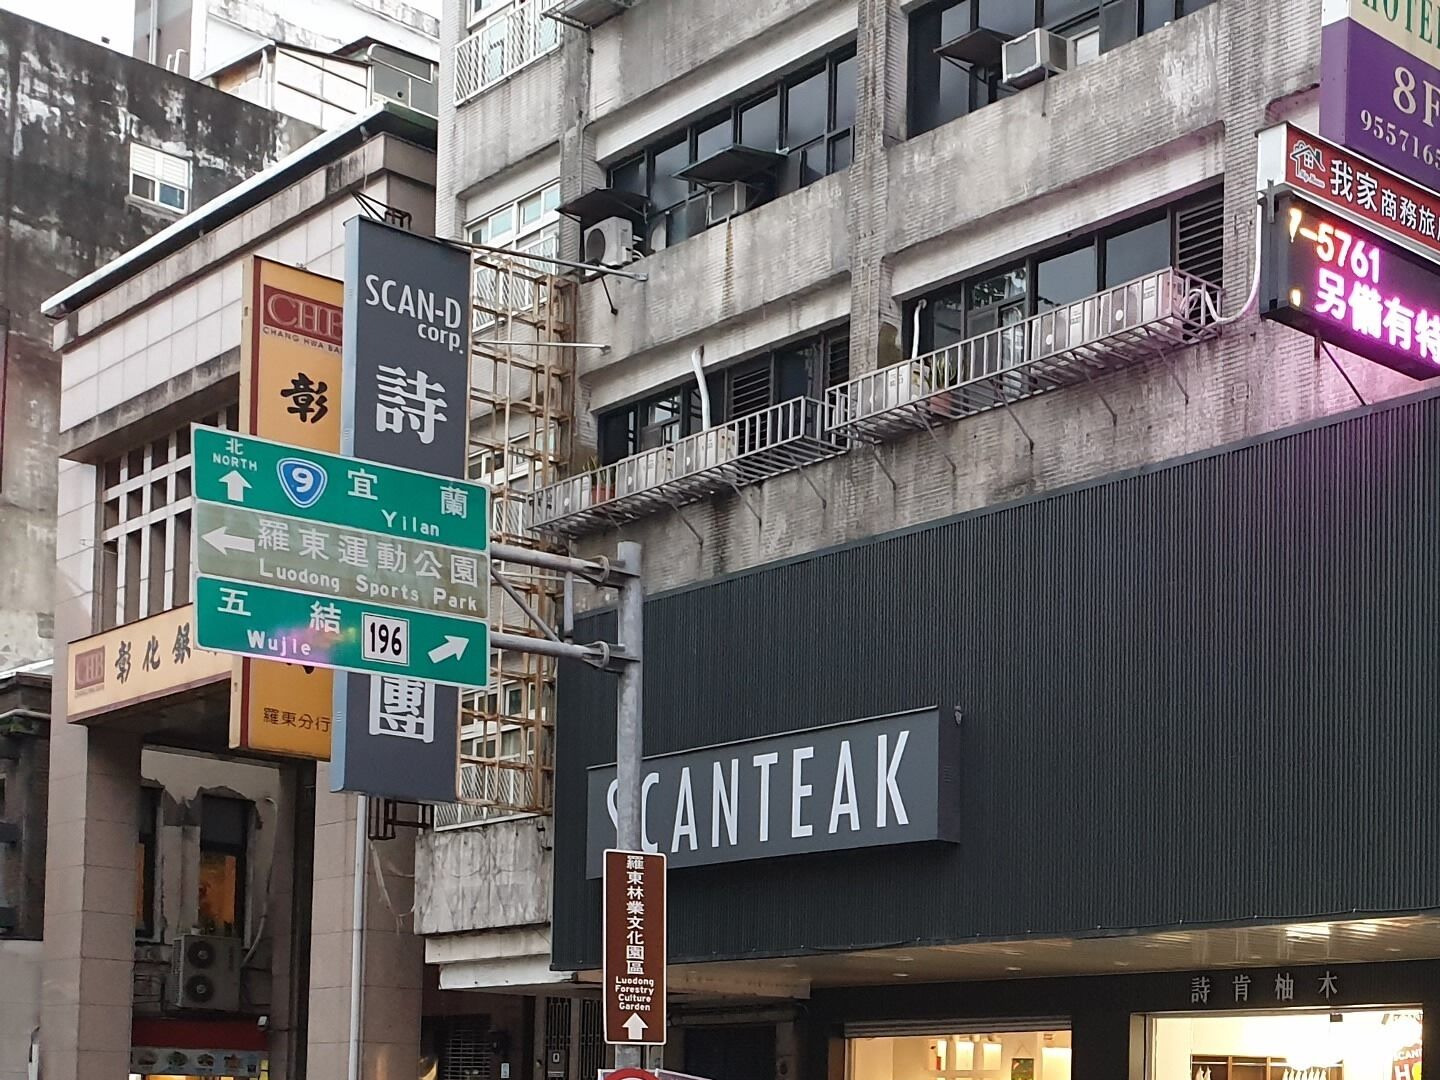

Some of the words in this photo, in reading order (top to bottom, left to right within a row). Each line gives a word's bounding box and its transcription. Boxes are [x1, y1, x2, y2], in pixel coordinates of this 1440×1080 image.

[365, 274, 461, 329] SCAN-D
[262, 327, 300, 342] CHANG
[303, 338, 324, 348] HWA
[328, 345, 343, 354] BA
[418, 323, 464, 354] corp.
[280, 372, 328, 423] 彰
[376, 365, 448, 444] 詩
[225, 438, 243, 455] 北
[213, 454, 257, 472] NORTH
[292, 468, 314, 493] 9
[347, 468, 468, 519] 宜蘭
[381, 510, 439, 537] Yilan
[258, 518, 478, 588] 羅東運動公園
[259, 558, 340, 593] Luodong
[356, 574, 419, 602] Sports
[433, 587, 477, 611] Park
[217, 588, 341, 633] 五結
[247, 630, 311, 657] Wujie
[370, 622, 402, 656] 196
[263, 707, 331, 732] 羅東分行
[626, 855, 644, 975] 羅東林業文化園區
[615, 975, 654, 987] Luodong
[615, 985, 654, 996] Forestry
[1191, 970, 1338, 1004] 詩肯柚木
[618, 993, 651, 1002] Culture
[619, 1002, 651, 1011] Garden
